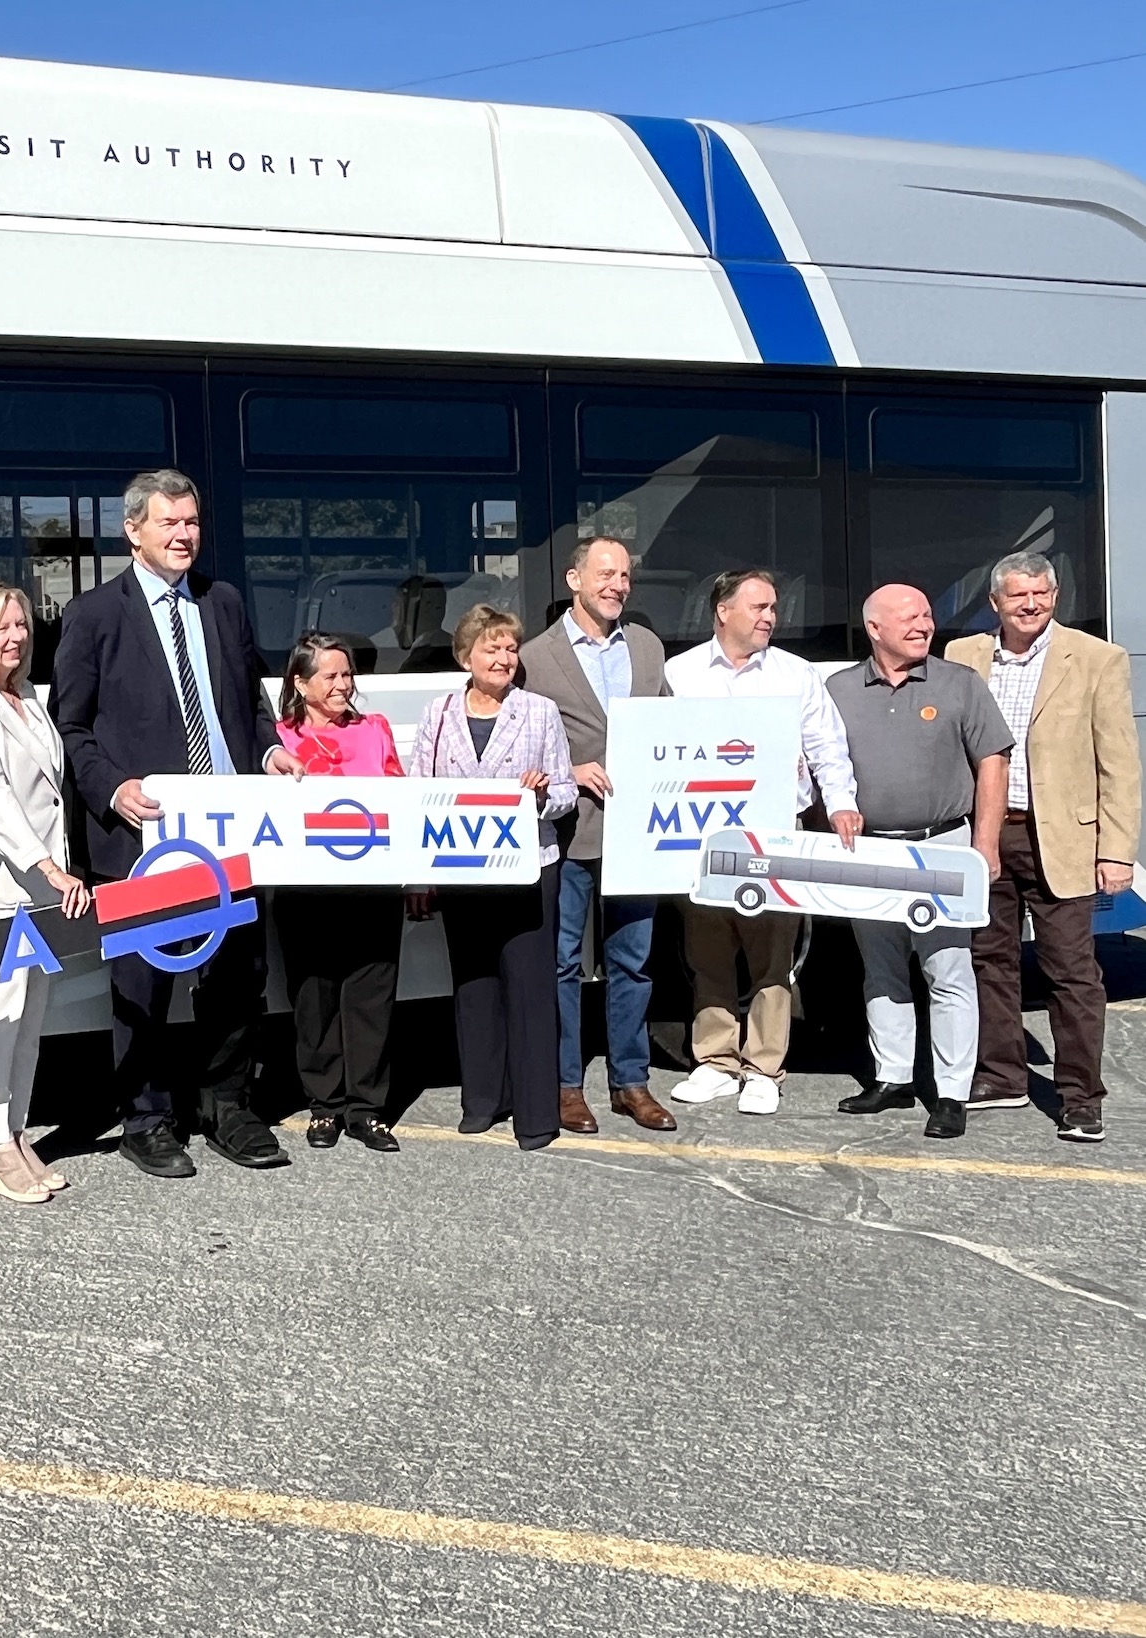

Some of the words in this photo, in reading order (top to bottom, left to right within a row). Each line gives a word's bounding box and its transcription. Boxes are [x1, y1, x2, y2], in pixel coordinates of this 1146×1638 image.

[103, 143, 352, 178] AUTHORITY
[653, 745, 707, 761] UTA
[157, 812, 284, 847] UTA
[421, 814, 522, 849] MVX
[647, 801, 748, 834] MVX
